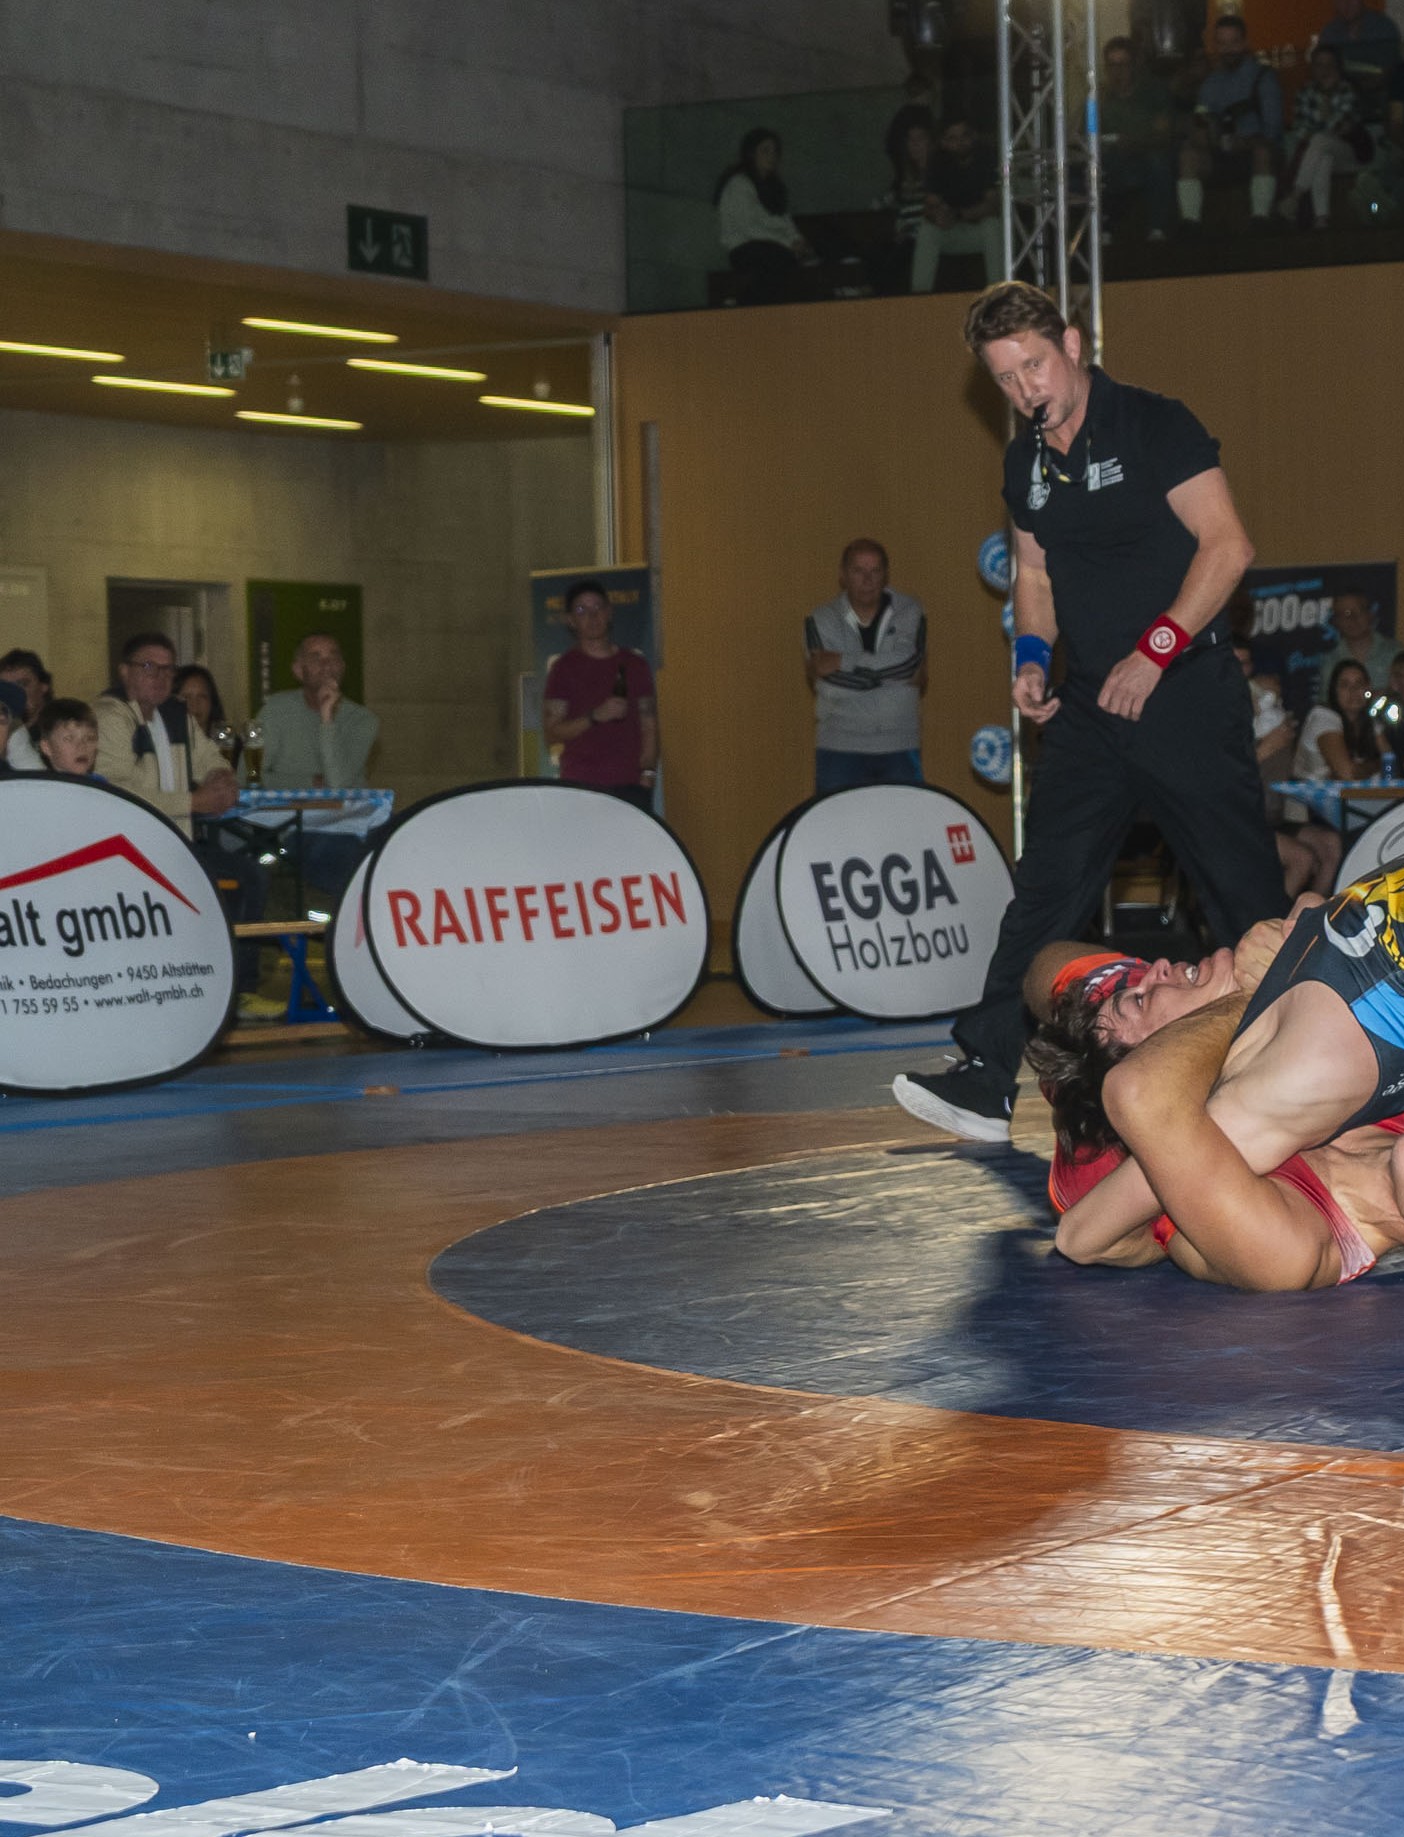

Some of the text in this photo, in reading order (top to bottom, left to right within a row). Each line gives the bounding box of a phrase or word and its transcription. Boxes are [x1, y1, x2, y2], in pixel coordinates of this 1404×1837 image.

[387, 871, 687, 948] RAIFFEISEN
[810, 848, 959, 922] EGGA
[56, 891, 173, 957] gmbh
[826, 919, 969, 972] Holzbau
[13, 998, 39, 1014] 755
[42, 998, 58, 1014] 59
[64, 996, 79, 1012] 55
[95, 985, 204, 1007] www.walt-gmbh.ch
[29, 970, 114, 991] Bedachungen
[127, 966, 158, 981] 9450
[162, 962, 215, 978] Altstätten
